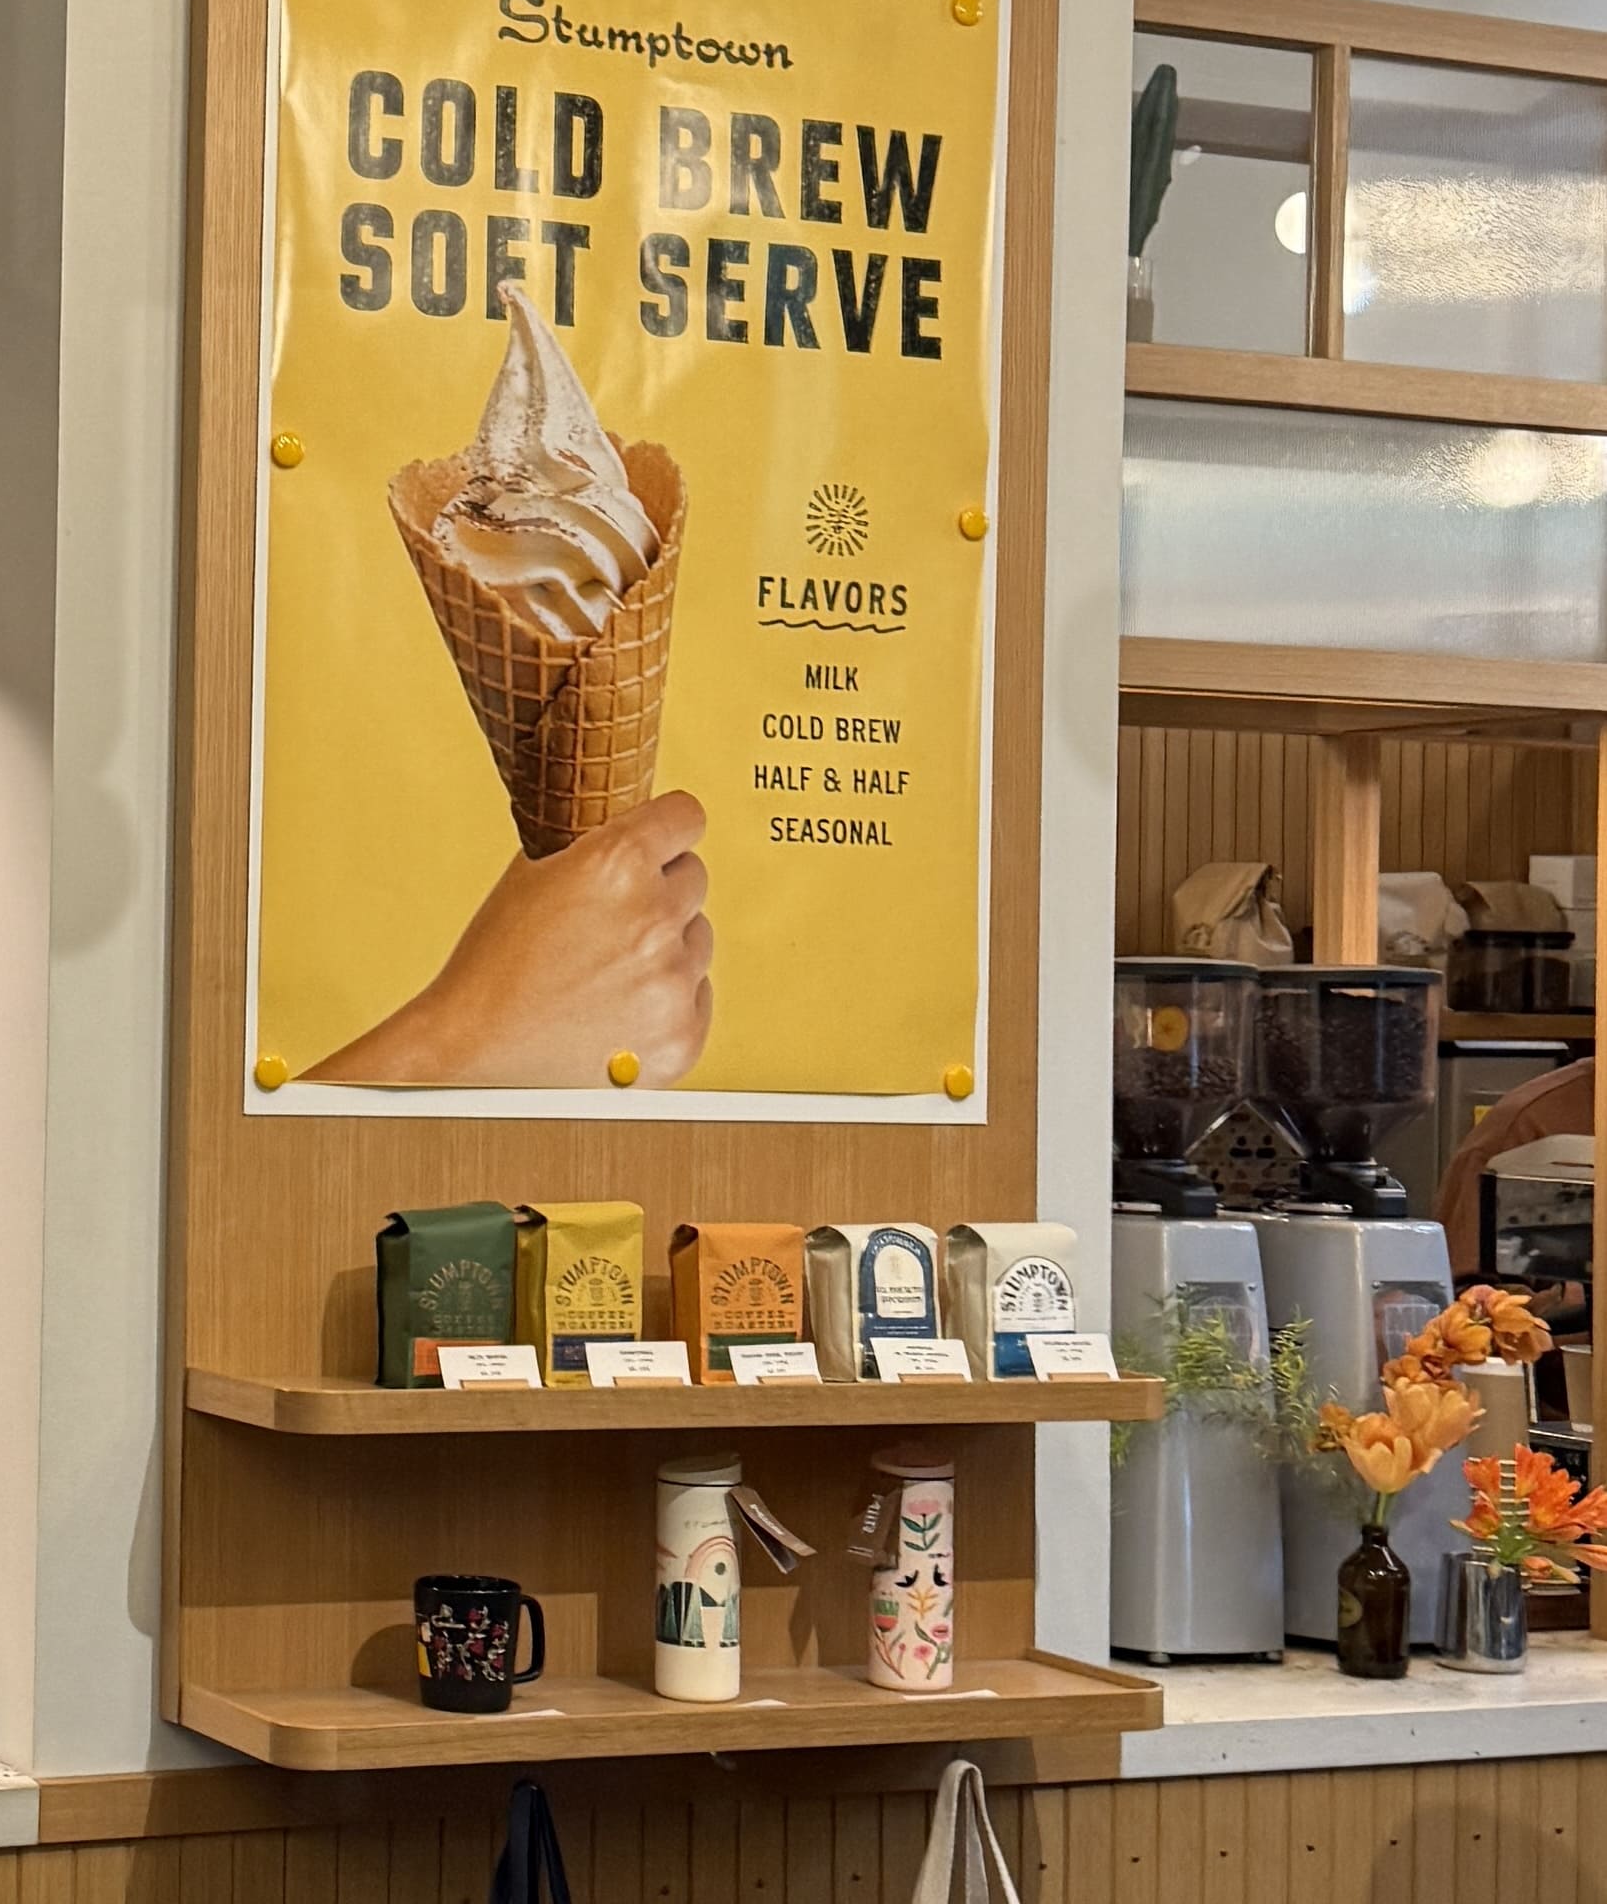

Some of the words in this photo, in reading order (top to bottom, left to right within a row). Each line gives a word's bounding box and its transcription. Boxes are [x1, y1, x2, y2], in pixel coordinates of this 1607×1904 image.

[347, 70, 604, 201] COLD
[658, 105, 943, 234] BREW
[339, 202, 592, 329] SOFT
[639, 232, 943, 361] SERVE
[758, 576, 909, 617] FLAVORS
[804, 664, 859, 692] MILK
[762, 714, 824, 744] COLD
[836, 716, 901, 746] BREW
[754, 765, 813, 794] HALF
[822, 768, 842, 794] &
[852, 769, 911, 797] HALF
[769, 816, 893, 847] SEASONAL
[555, 1256, 635, 1307] STUMPTOWN
[711, 1256, 795, 1306] STUMPTOWN
[1000, 1263, 1069, 1312] STUMPTOWN
